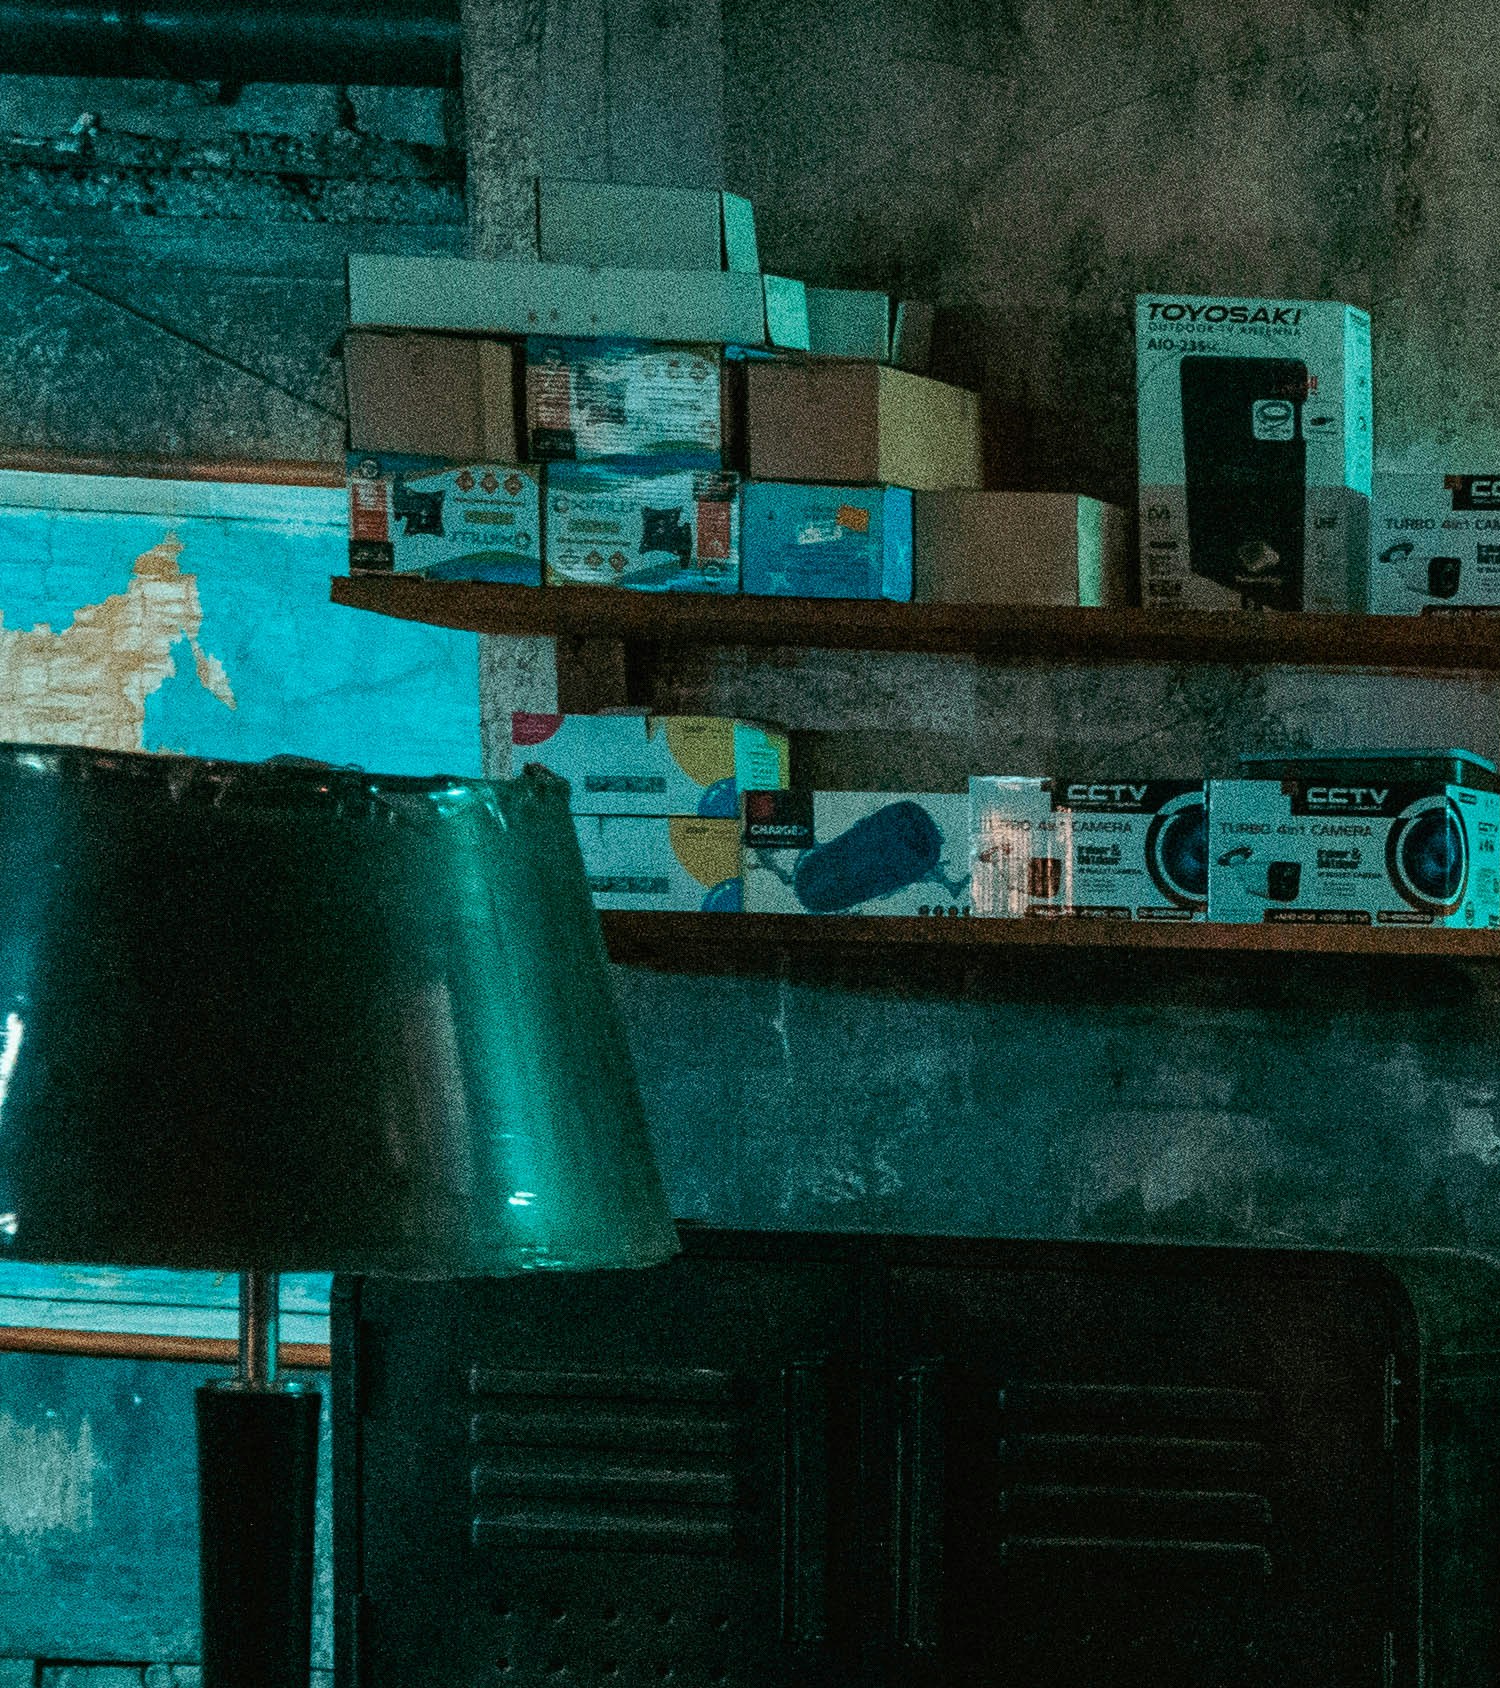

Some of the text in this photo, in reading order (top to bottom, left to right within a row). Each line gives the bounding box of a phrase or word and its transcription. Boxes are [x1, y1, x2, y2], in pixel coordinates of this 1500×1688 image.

[1147, 303, 1303, 326] TOYOSAKI
[1385, 518, 1436, 531] TURBO
[1067, 784, 1149, 801] CCTV
[1306, 787, 1389, 804] CCTV
[1073, 820, 1132, 833] CAMERA
[1220, 822, 1271, 835] TURBO
[1311, 824, 1373, 836] CAMERA
